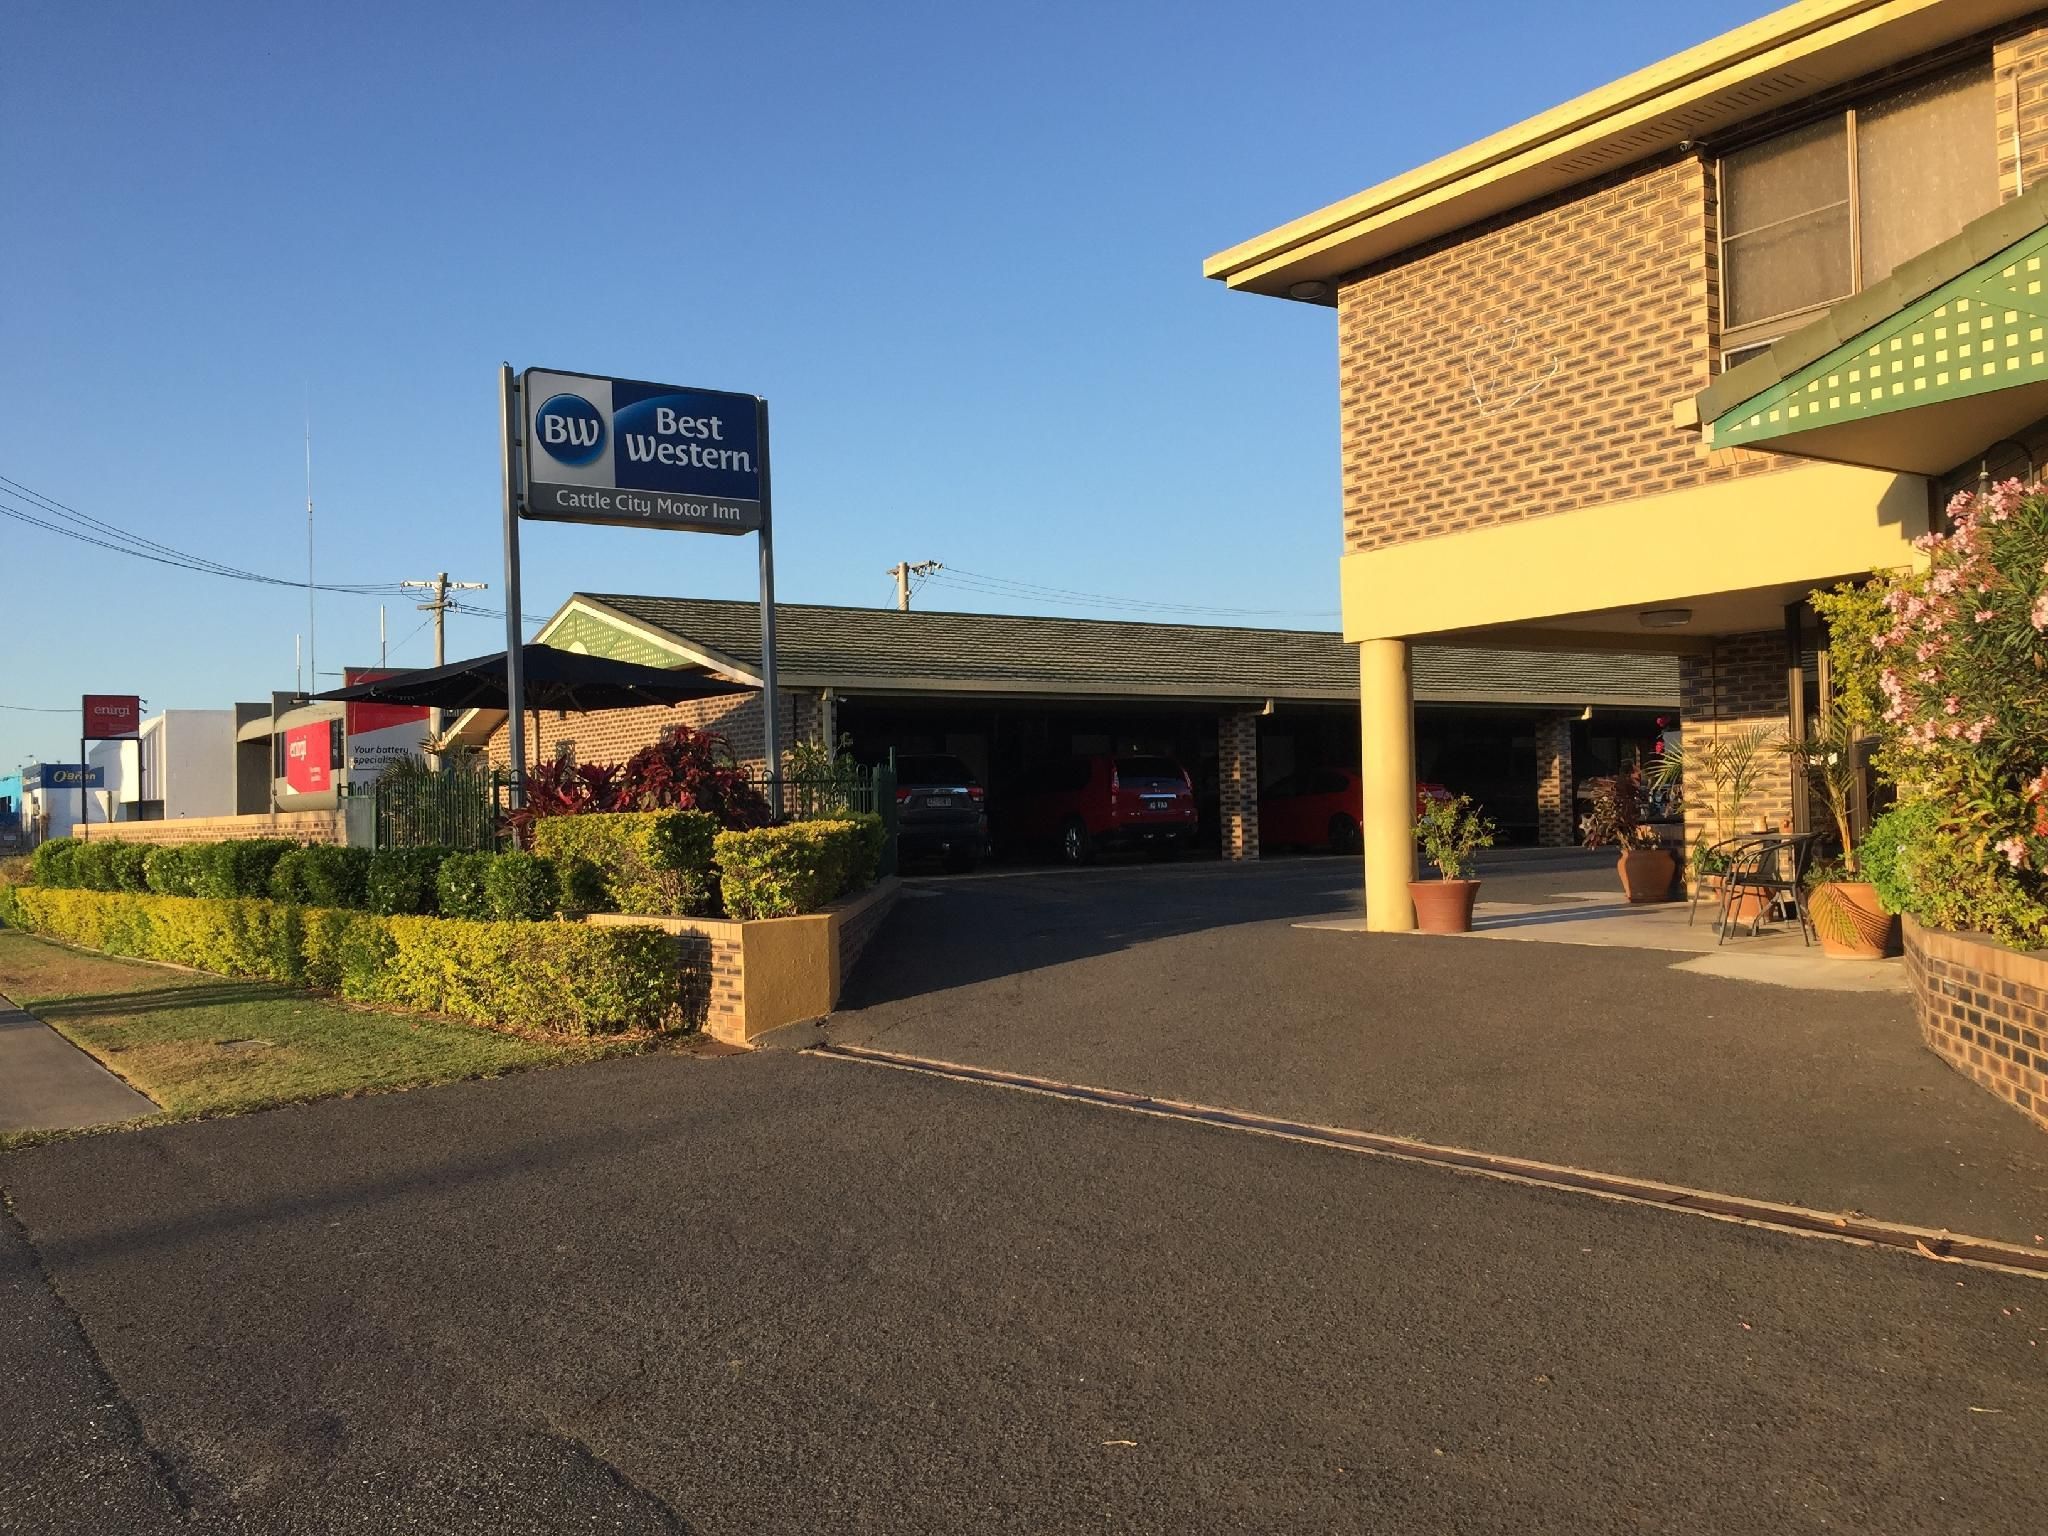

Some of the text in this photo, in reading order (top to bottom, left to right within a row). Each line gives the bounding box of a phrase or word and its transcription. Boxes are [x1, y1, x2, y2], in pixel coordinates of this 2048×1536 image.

[545, 414, 599, 447] BW
[656, 407, 724, 441] Best
[625, 433, 751, 473] Western
[556, 489, 741, 520] Cattle City Motor Inn
[94, 705, 130, 717] enirgi
[354, 745, 409, 756] Your battery
[53, 770, 96, 782] O'Brn
